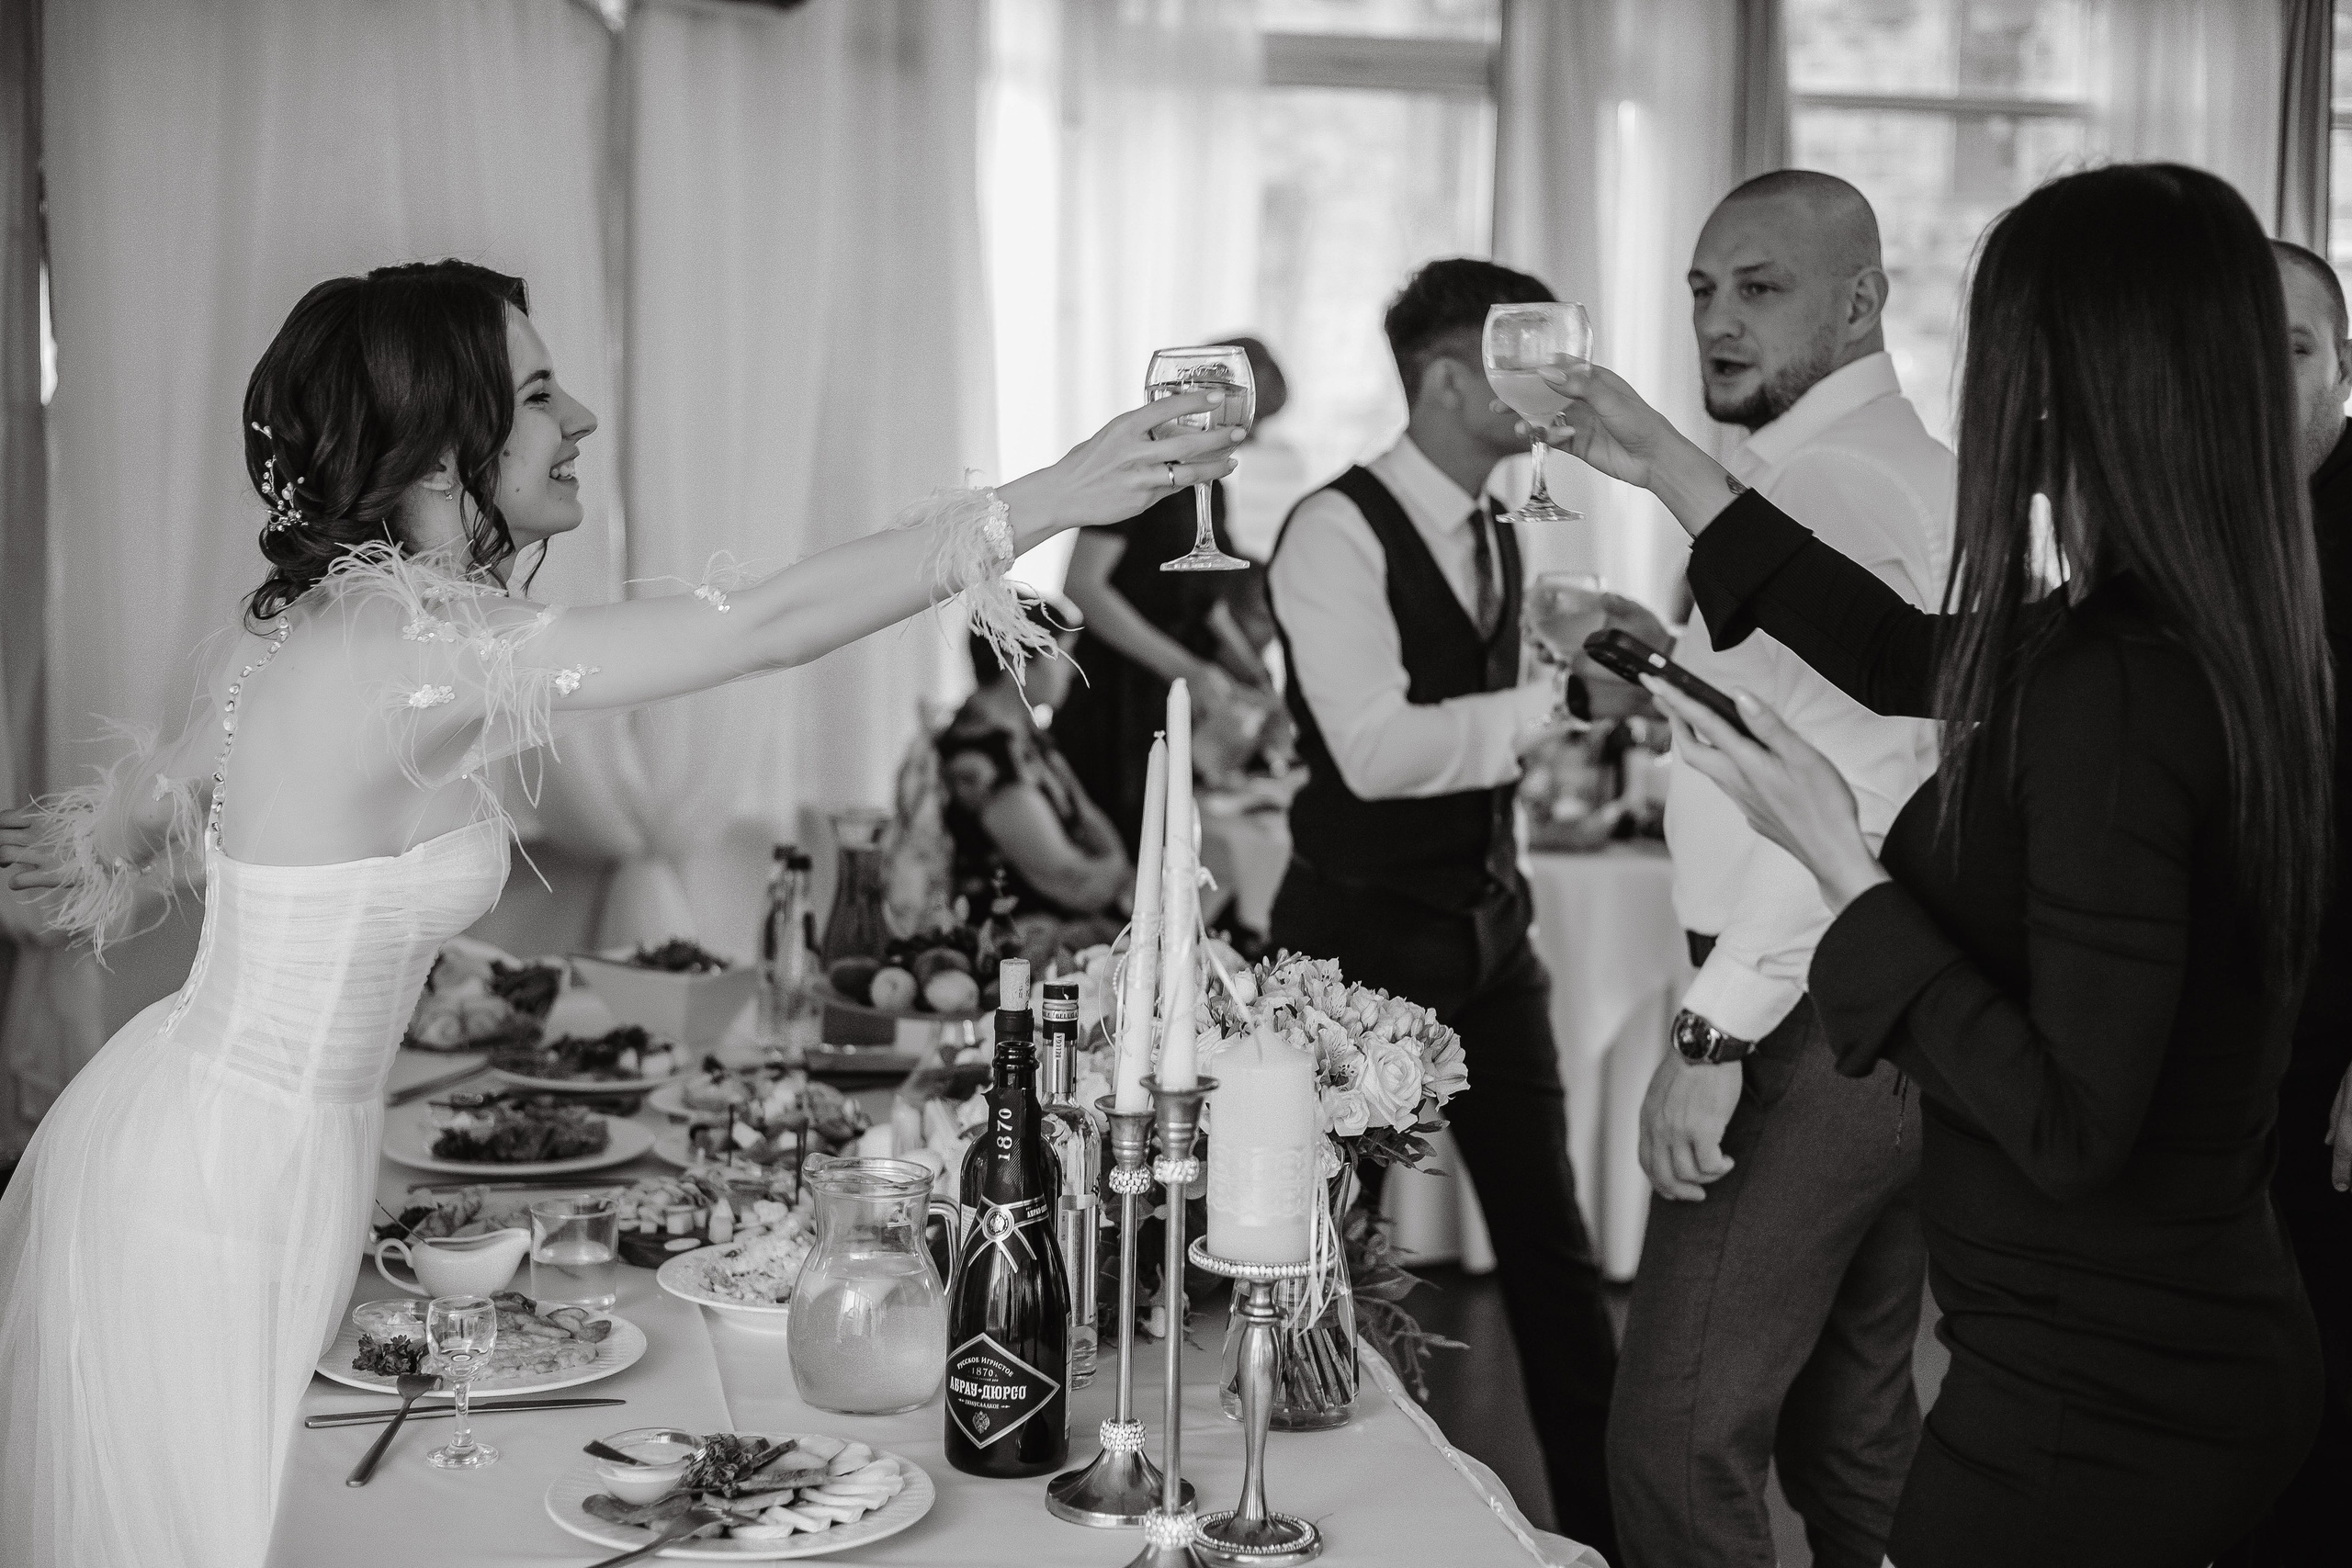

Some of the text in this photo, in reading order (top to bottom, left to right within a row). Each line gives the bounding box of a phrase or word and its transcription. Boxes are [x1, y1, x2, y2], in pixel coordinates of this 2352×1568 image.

[1055, 1034, 1063, 1058] BELUGA
[997, 1108, 1013, 1161] 1870
[956, 1356, 1014, 1378] РУССКОЕ ИГРИСТОЕ
[971, 1367, 994, 1377] 1870
